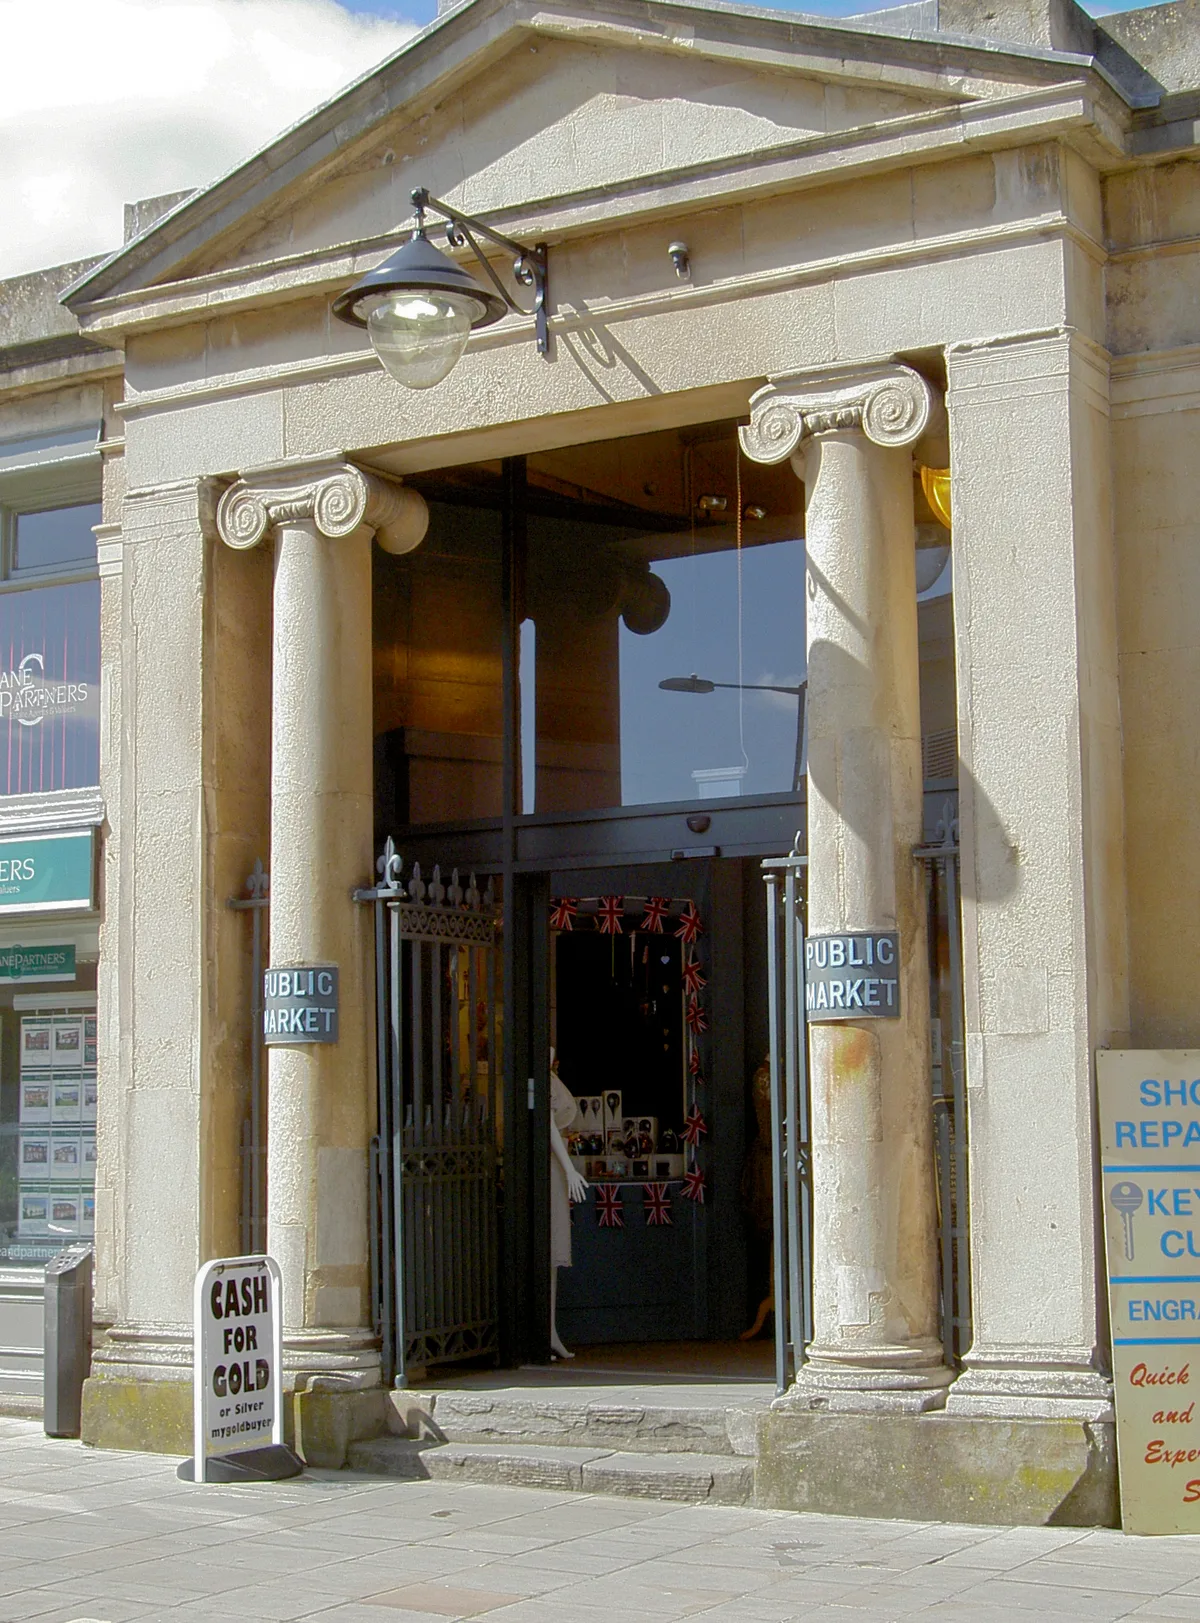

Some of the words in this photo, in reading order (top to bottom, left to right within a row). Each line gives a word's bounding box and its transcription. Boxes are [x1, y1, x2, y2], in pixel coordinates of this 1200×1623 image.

[0, 683, 88, 717] PARTNERS
[0, 858, 35, 881] ERS
[806, 937, 894, 970] PUBLIC
[806, 979, 897, 1011] MARKET
[1115, 1121, 1200, 1148] REPA
[211, 1275, 268, 1320] CASH
[1128, 1300, 1200, 1321] ENGR
[223, 1325, 258, 1355] FOR
[212, 1359, 270, 1398] GOLD
[1129, 1362, 1190, 1388] Quick
[219, 1407, 231, 1418] or
[235, 1401, 264, 1416] Silver
[1152, 1402, 1196, 1424] and
[211, 1417, 272, 1439] mygoldbuyer
